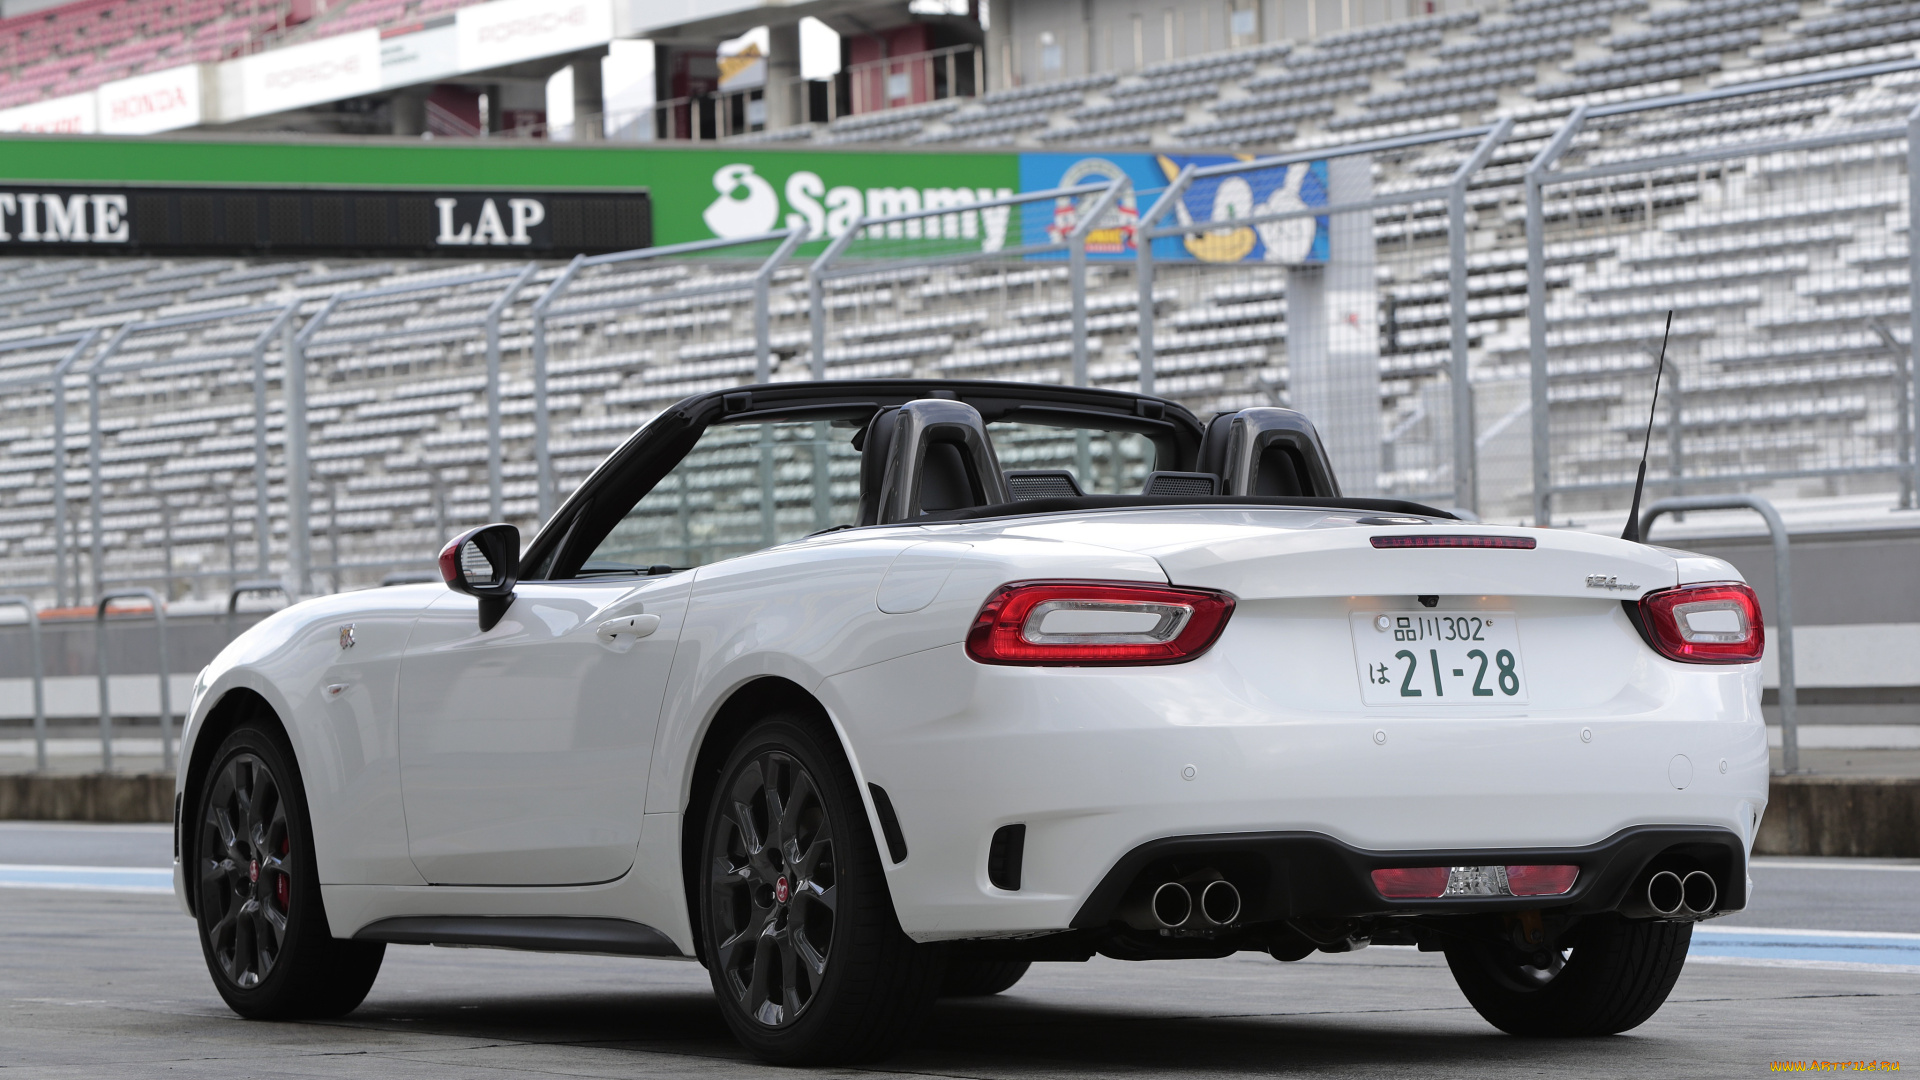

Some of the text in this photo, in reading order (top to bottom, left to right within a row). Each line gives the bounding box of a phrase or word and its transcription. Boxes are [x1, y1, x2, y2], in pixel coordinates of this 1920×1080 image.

[478, 4, 588, 43] PORSCHE
[265, 55, 361, 89] PORSCHE
[110, 86, 187, 122] HONDA
[435, 199, 545, 246] LAP
[785, 171, 1013, 254] Sammy
[1395, 649, 1520, 697] 21-28
